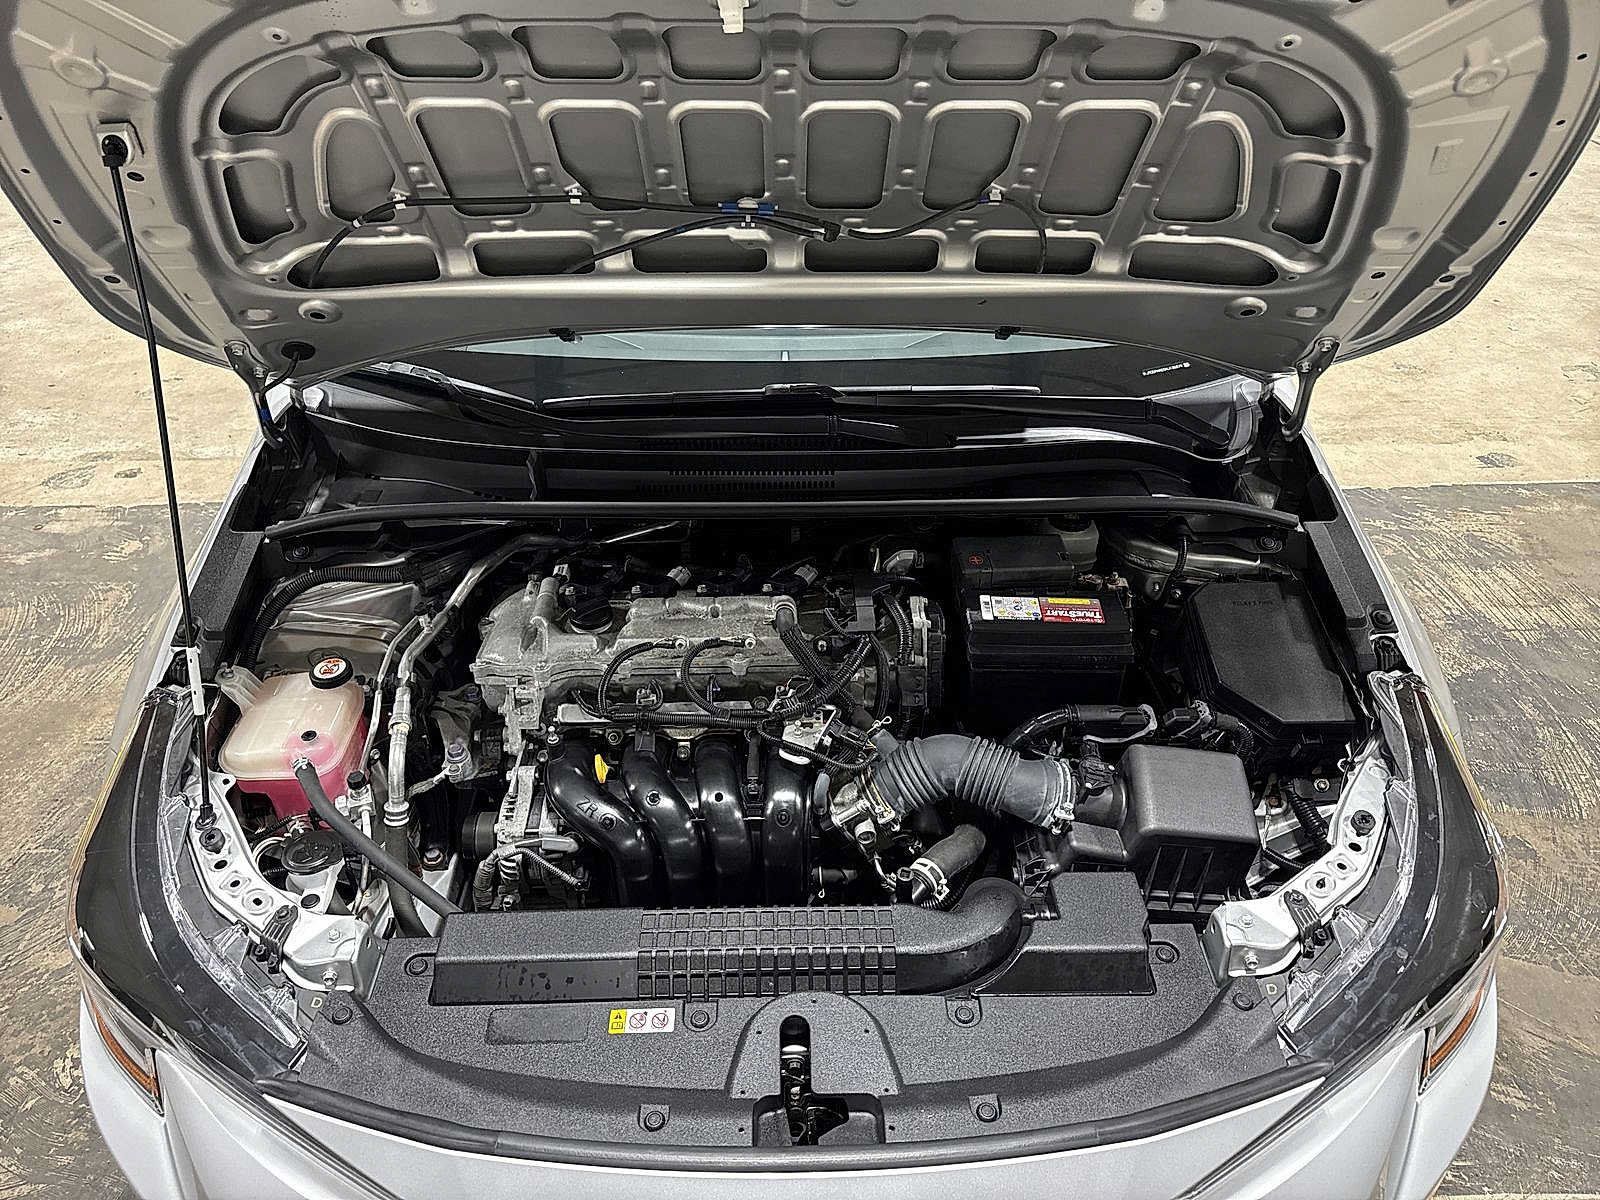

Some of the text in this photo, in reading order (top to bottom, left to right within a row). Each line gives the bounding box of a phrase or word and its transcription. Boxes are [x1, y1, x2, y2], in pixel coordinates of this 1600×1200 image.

[576, 795, 598, 818] ZR
[1266, 984, 1277, 994] D
[311, 997, 322, 1008] D
